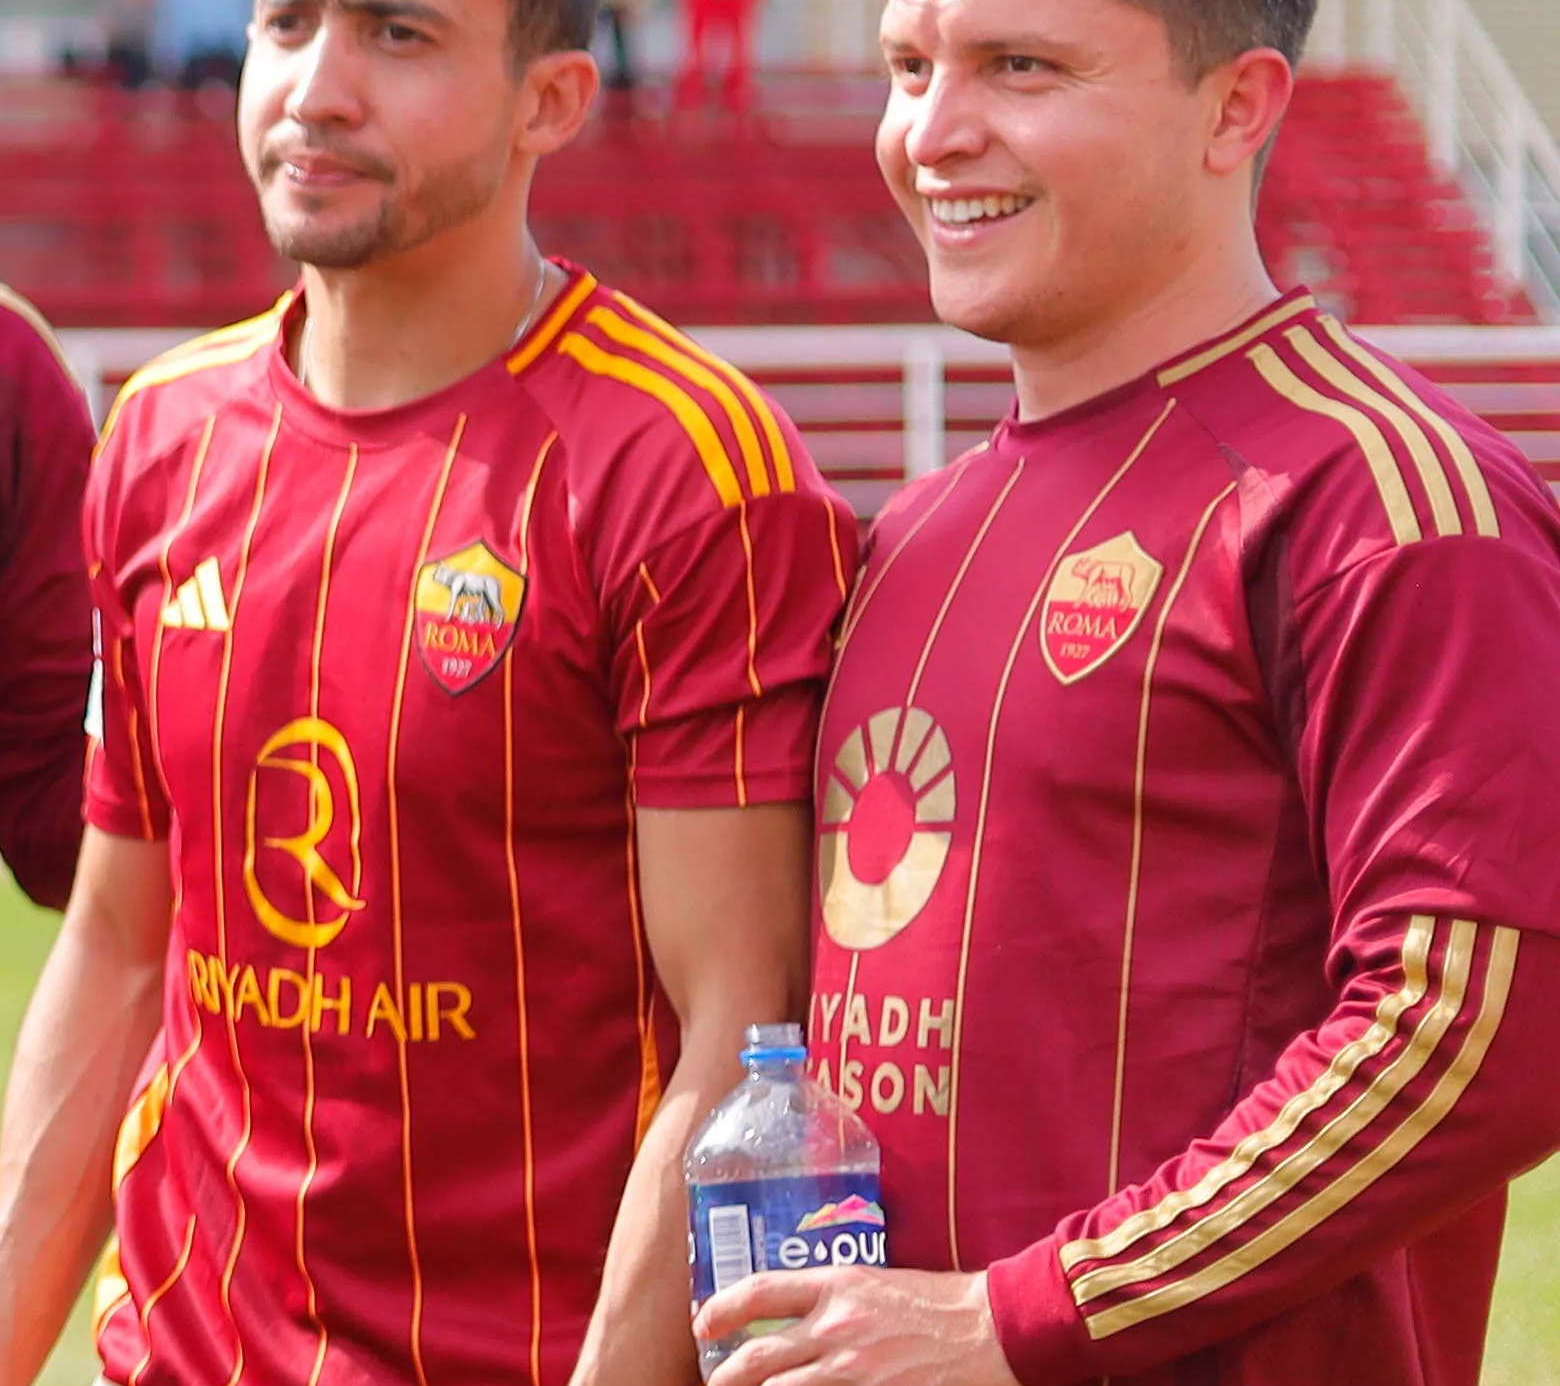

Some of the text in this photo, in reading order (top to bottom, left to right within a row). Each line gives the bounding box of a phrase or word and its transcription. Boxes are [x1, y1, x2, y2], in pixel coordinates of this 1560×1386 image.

[424, 621, 496, 660] ROMA
[1046, 610, 1119, 640] ROMA
[1060, 642, 1090, 660] 1927
[187, 948, 477, 1043] RIYADH AIR
[806, 1057, 951, 1117] ASON
